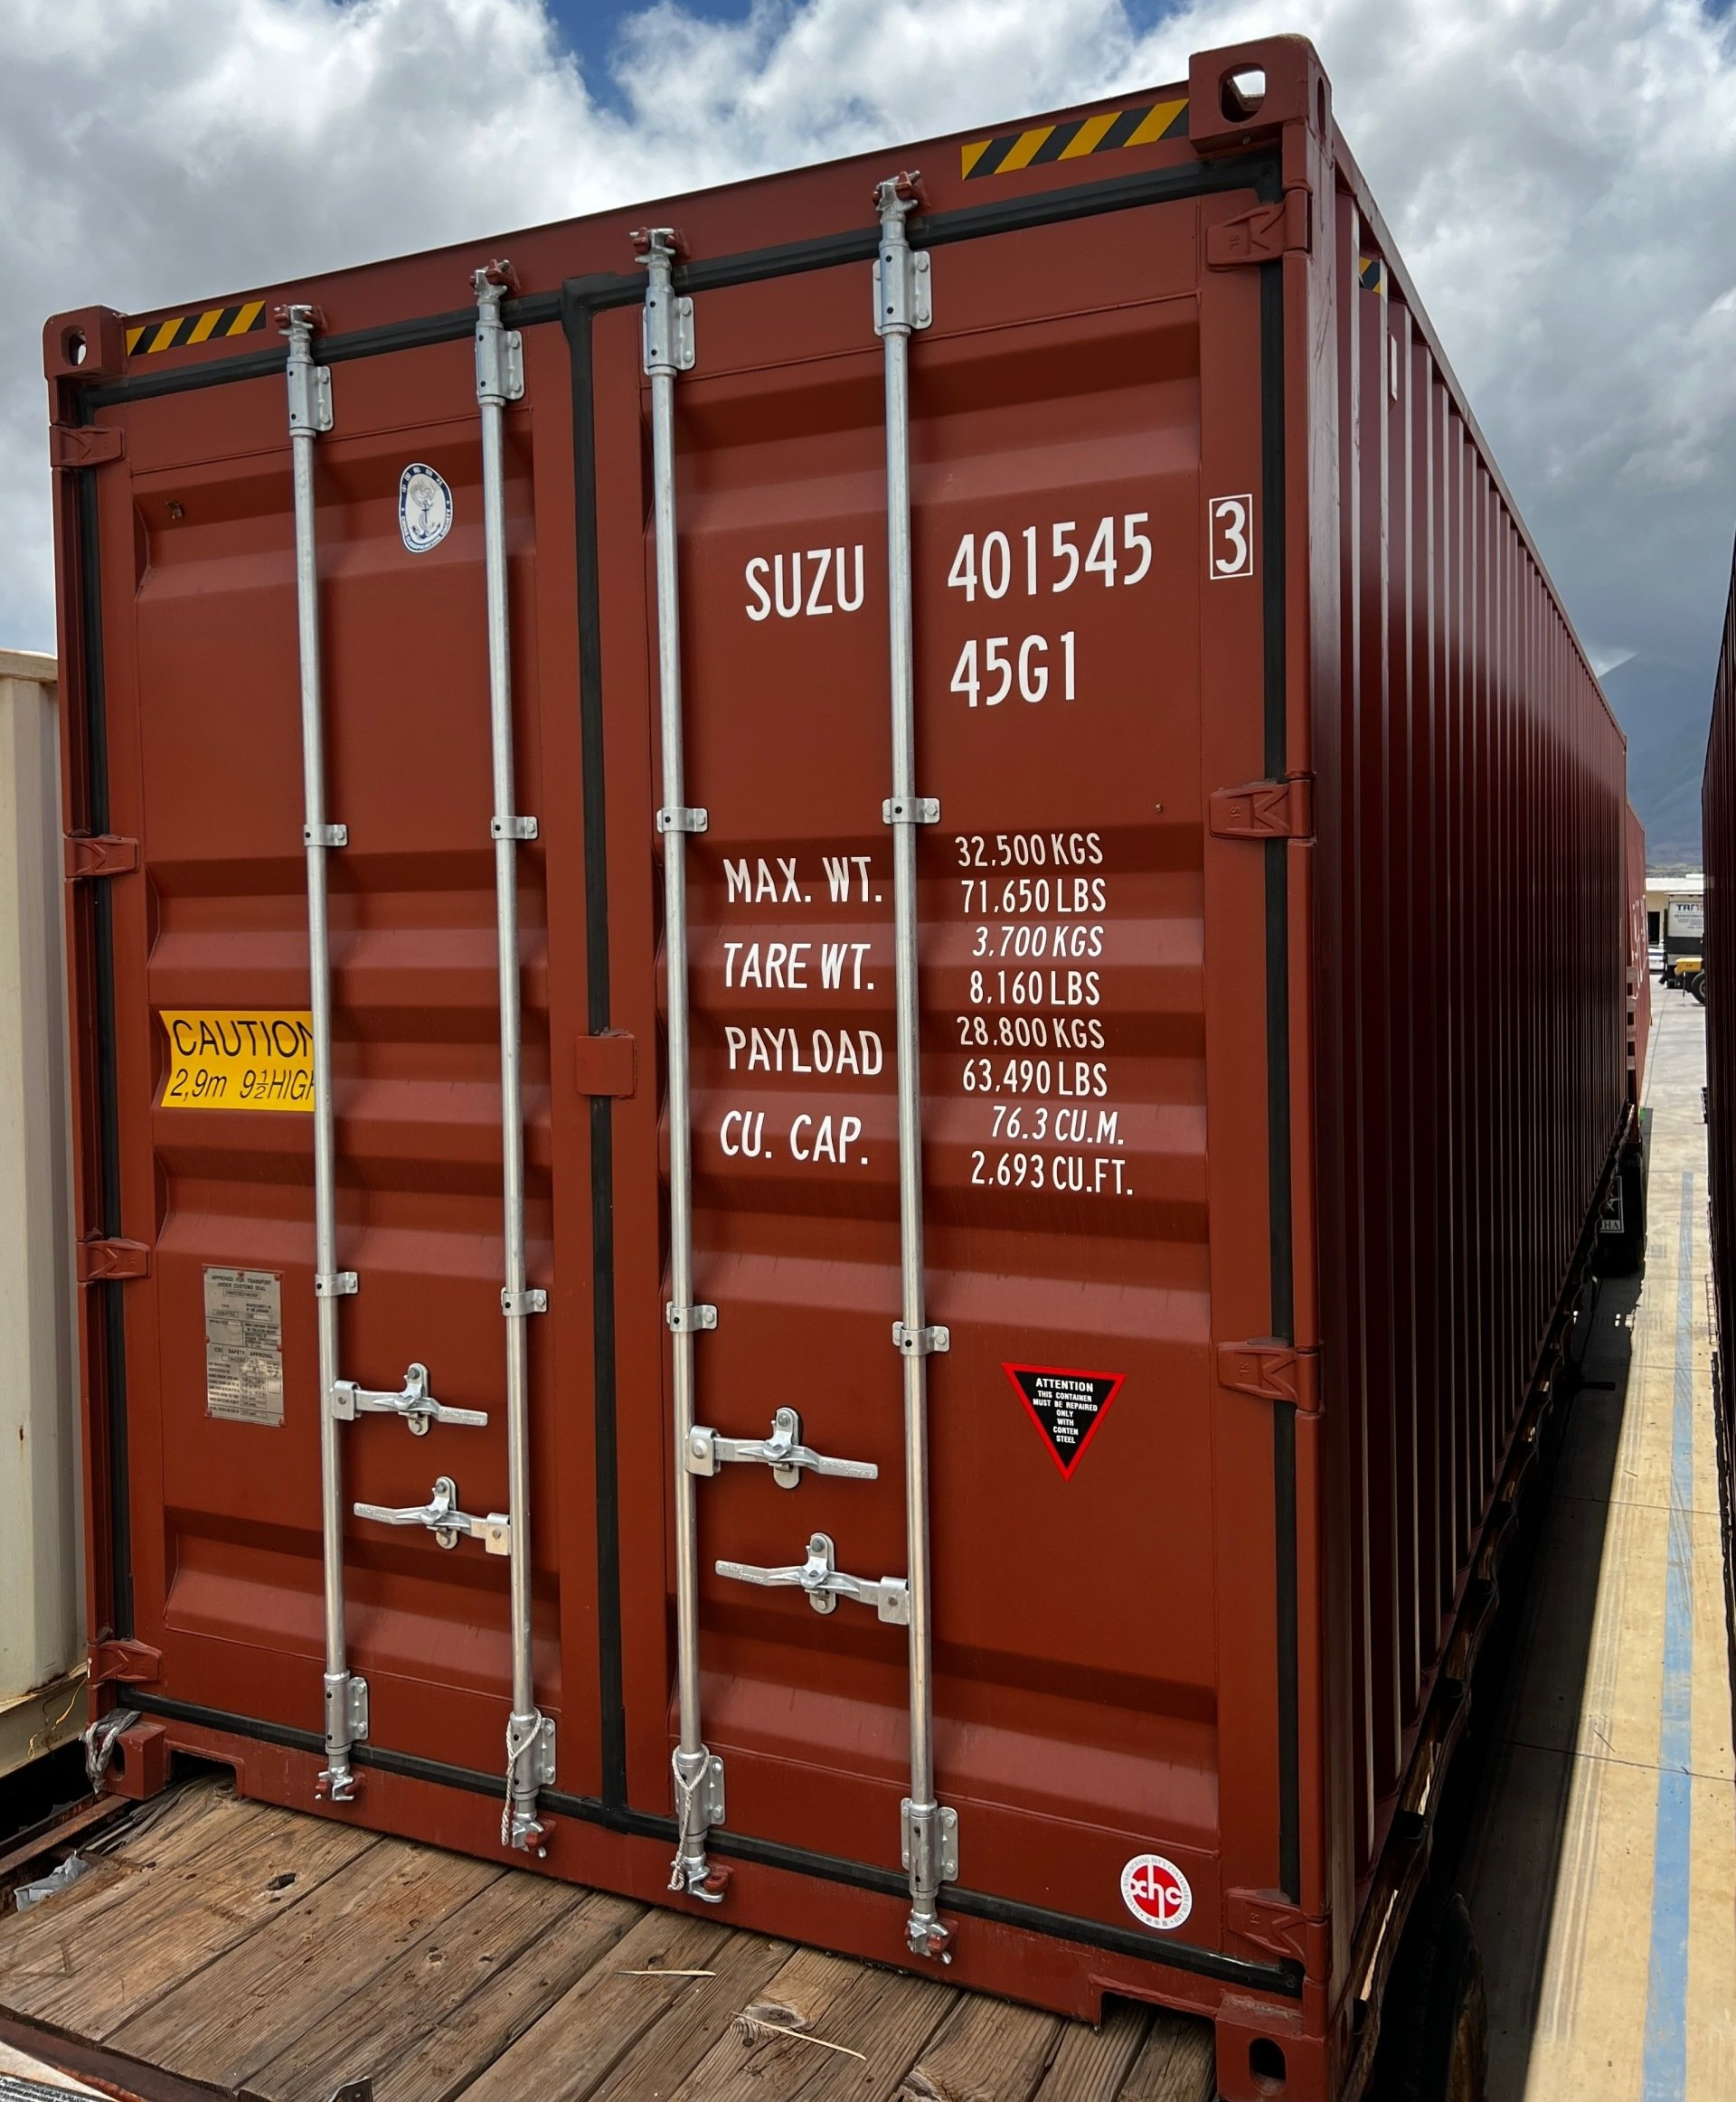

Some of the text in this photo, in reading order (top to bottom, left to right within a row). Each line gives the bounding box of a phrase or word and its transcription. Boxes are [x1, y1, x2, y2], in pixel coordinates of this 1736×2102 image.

[745, 499, 1248, 621] SUZU 401545 3
[950, 631, 1075, 708] 45G1
[1051, 832, 1103, 865] KGS
[722, 856, 882, 903] MAX. WT.
[1057, 878, 1107, 912] LBS
[1052, 925, 1104, 957] KGS
[723, 942, 874, 990] TARE WT.
[1051, 970, 1100, 1006] LBS
[1052, 1017, 1105, 1050] KGS
[724, 1026, 883, 1076] PAYLOAD
[170, 1068, 227, 1102] 2,9m
[1058, 1060, 1108, 1098] LBS
[720, 1110, 868, 1164] CU. CAP.
[992, 1105, 1124, 1145] 76.3 CU.M.
[1052, 1155, 1133, 1195] CU.FT.
[1035, 1378, 1094, 1392] ATTENTION
[1037, 1390, 1092, 1402] THIS CONTAINER
[1033, 1398, 1099, 1412] MUST BE REPAIRED
[1056, 1409, 1074, 1418] ONLY
[1052, 1426, 1079, 1436] CORTEN
[1055, 1435, 1076, 1444] STEEL
[1056, 1418, 1074, 1427] WITH
